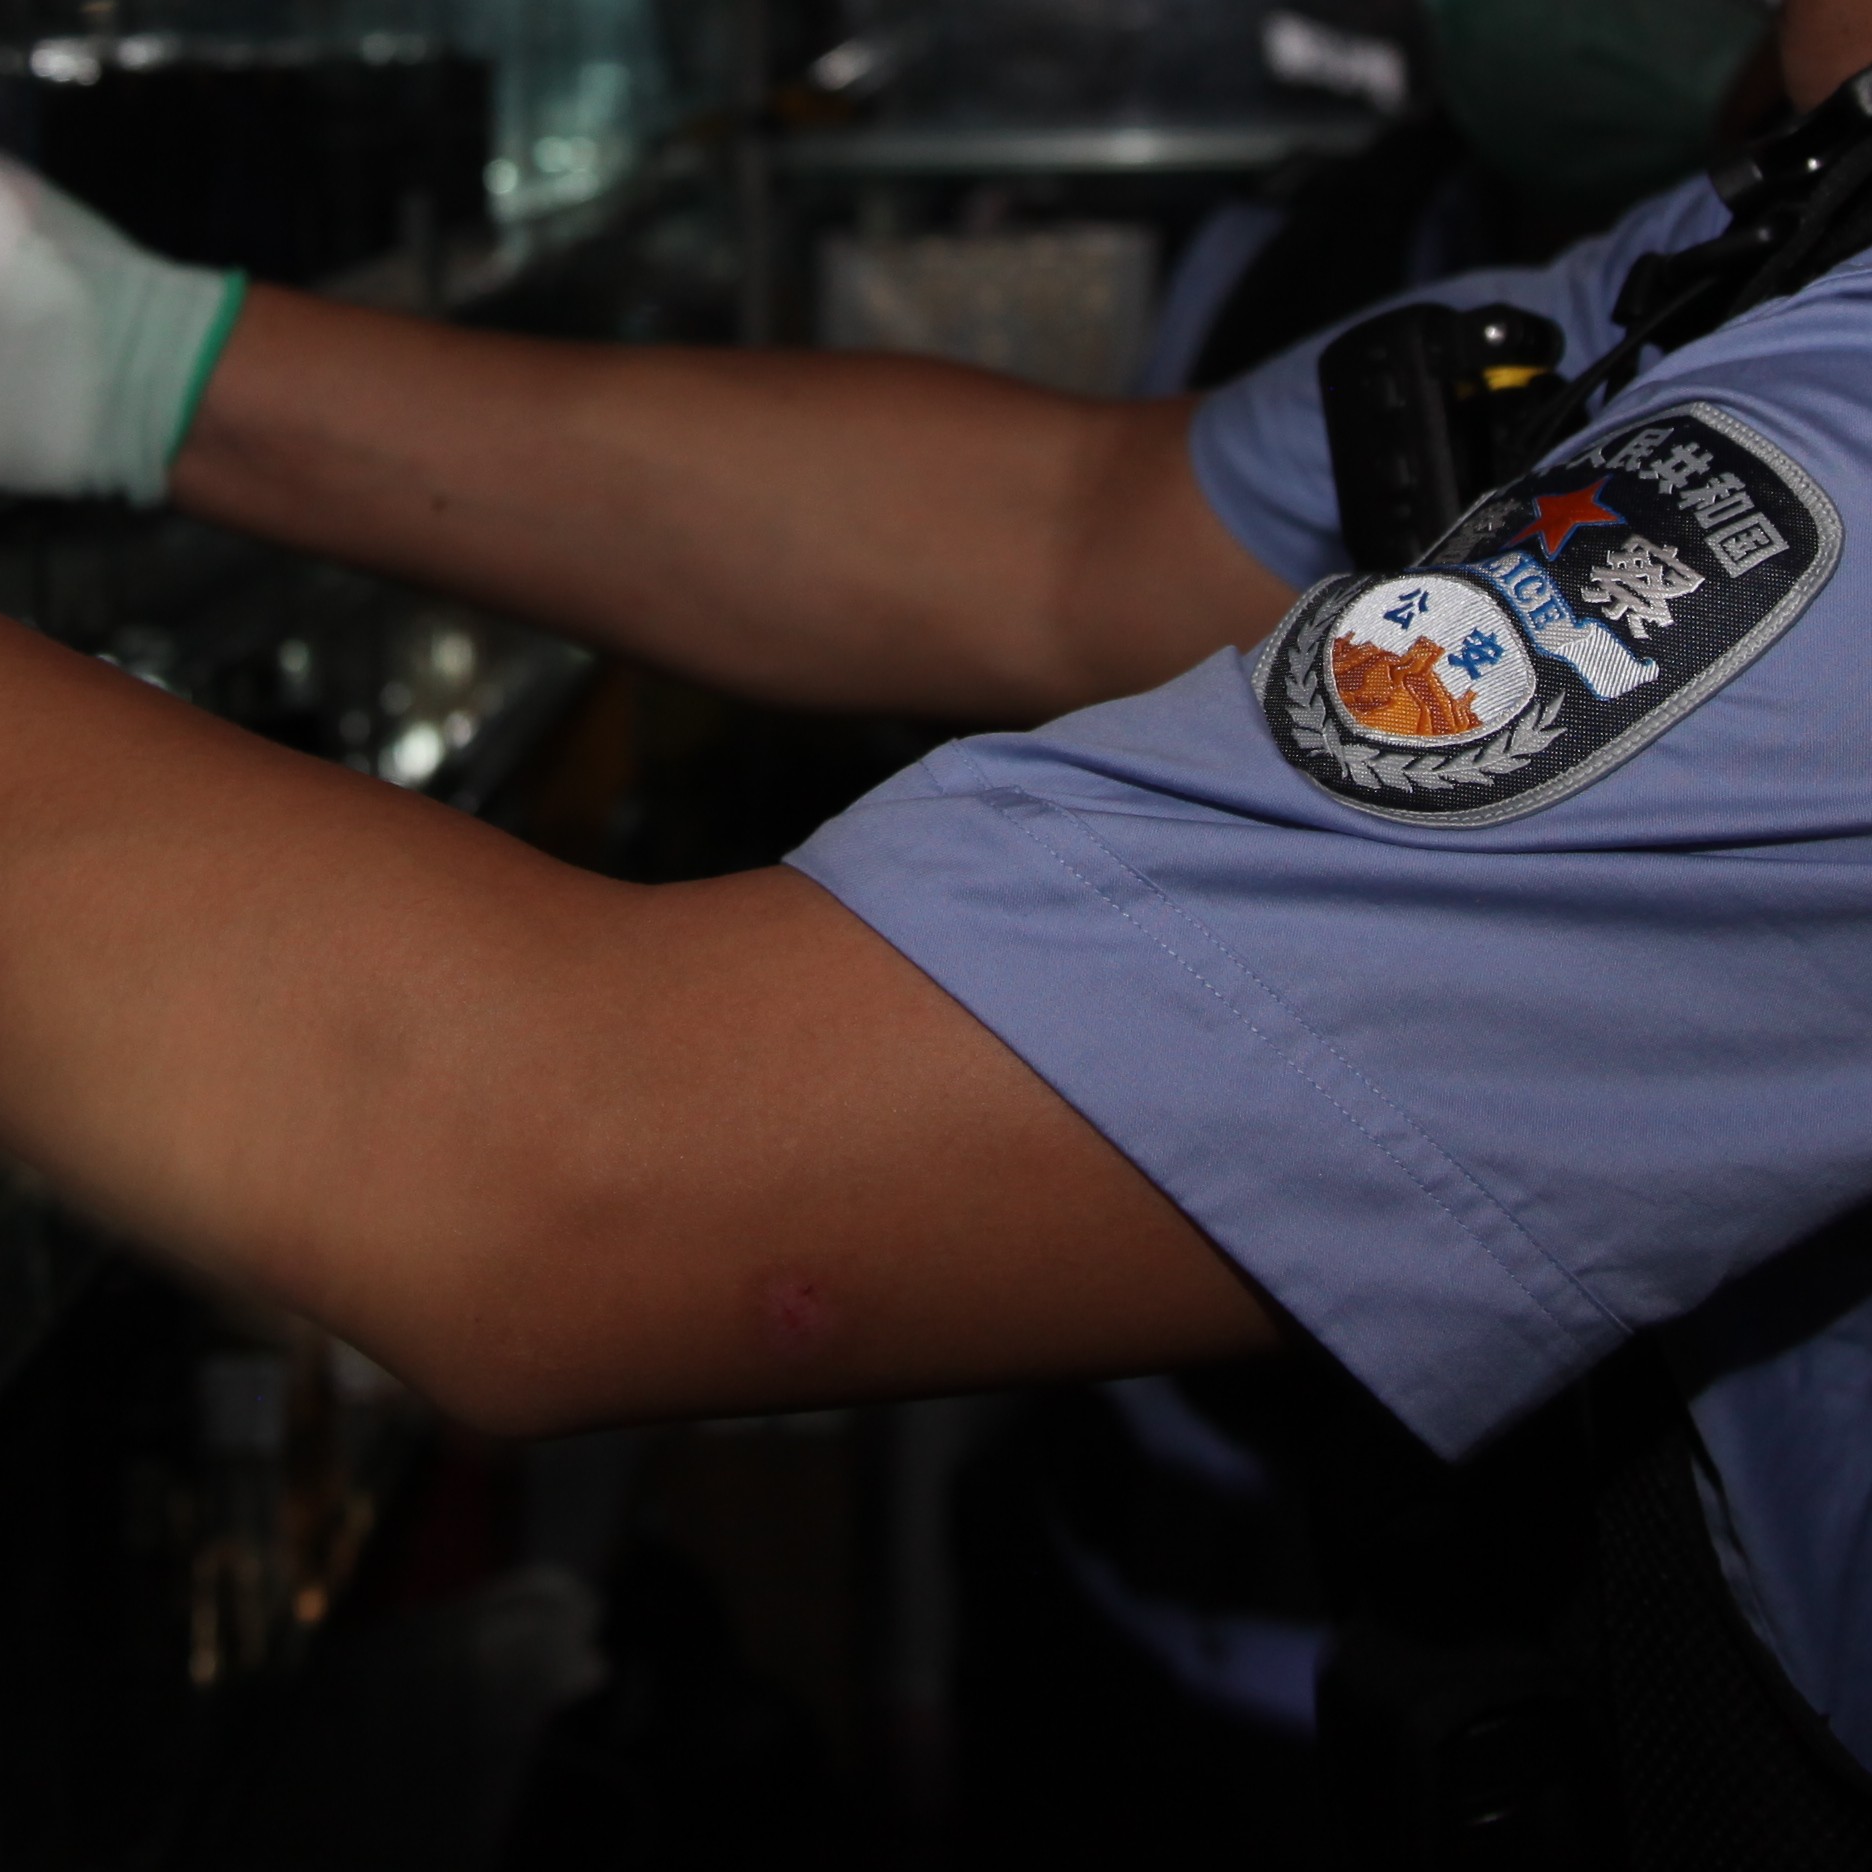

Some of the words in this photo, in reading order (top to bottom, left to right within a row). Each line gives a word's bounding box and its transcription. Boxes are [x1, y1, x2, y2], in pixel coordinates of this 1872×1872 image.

[1540, 425, 1791, 579] 人民共和国
[1382, 586, 1506, 681] 公安
